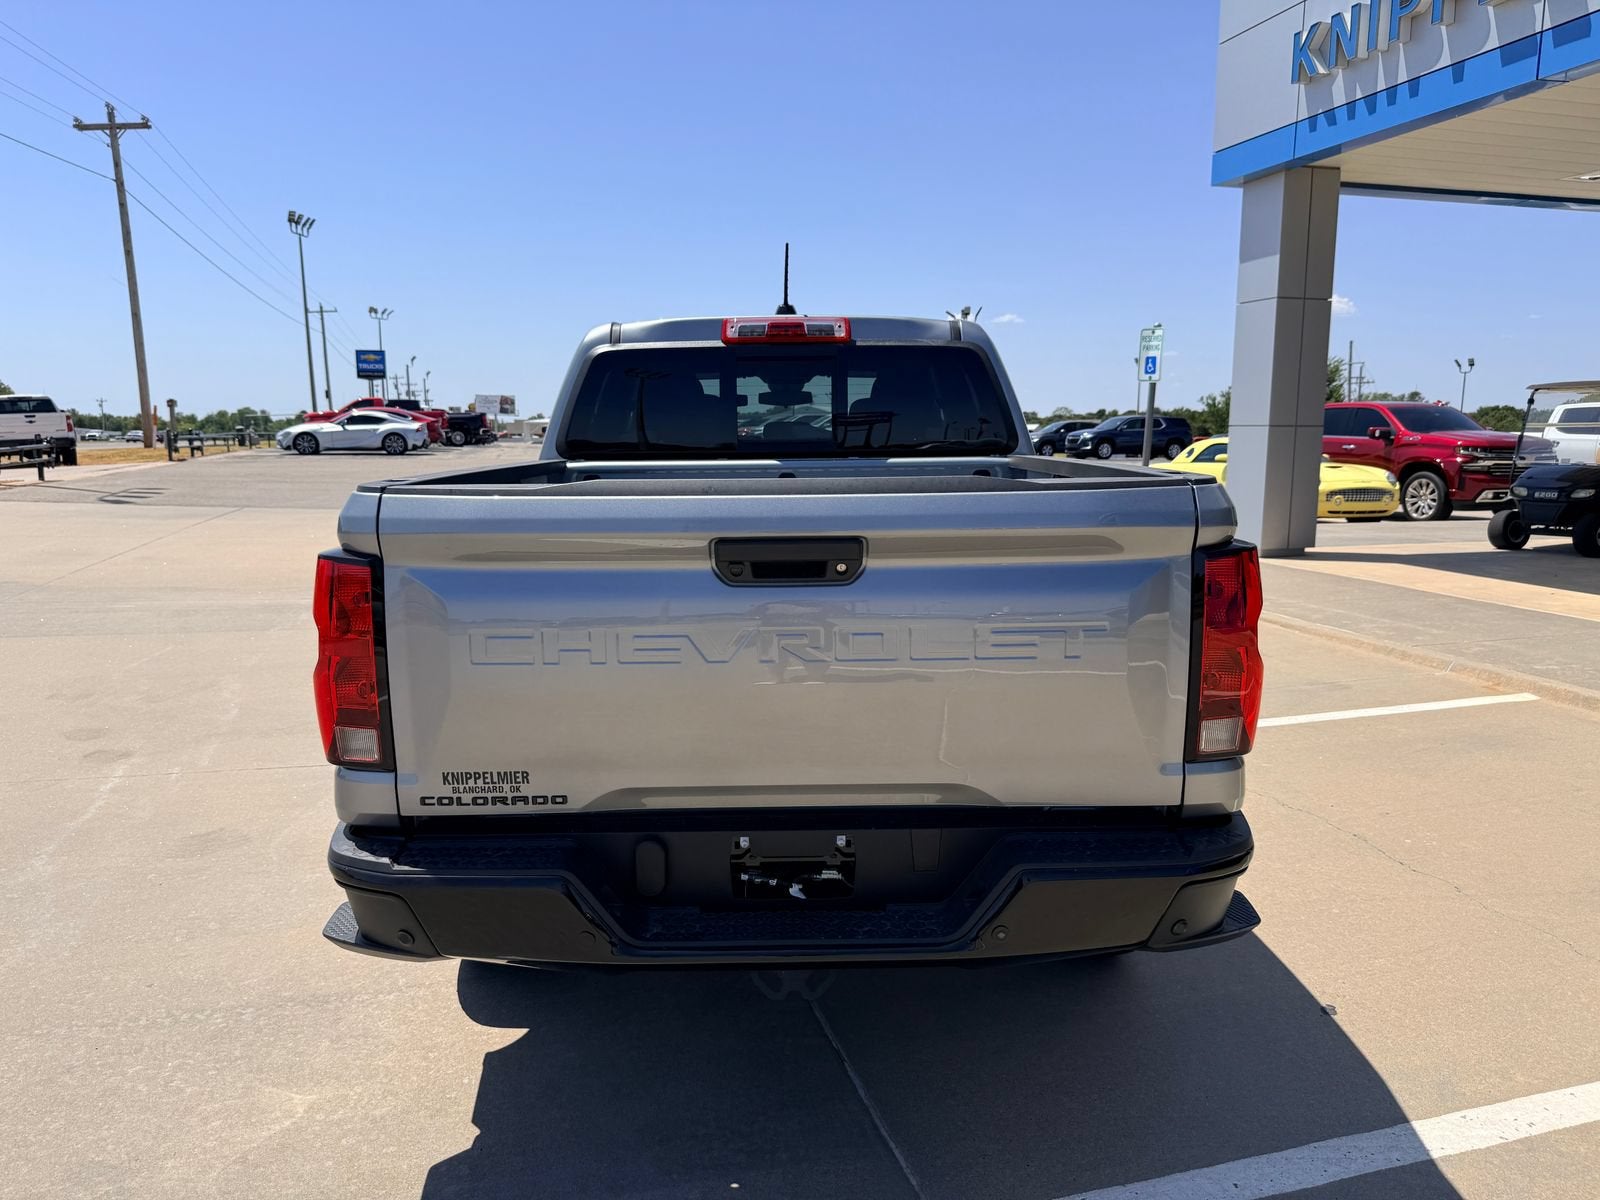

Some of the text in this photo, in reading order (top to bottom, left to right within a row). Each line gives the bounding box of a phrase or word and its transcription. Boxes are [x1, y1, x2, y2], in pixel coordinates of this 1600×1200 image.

[468, 621, 1110, 666] CHEVROLET
[442, 770, 530, 785] KNIPPELMIER
[452, 785, 522, 795] BLANCHARD, OK
[419, 794, 568, 807] COLORADO
